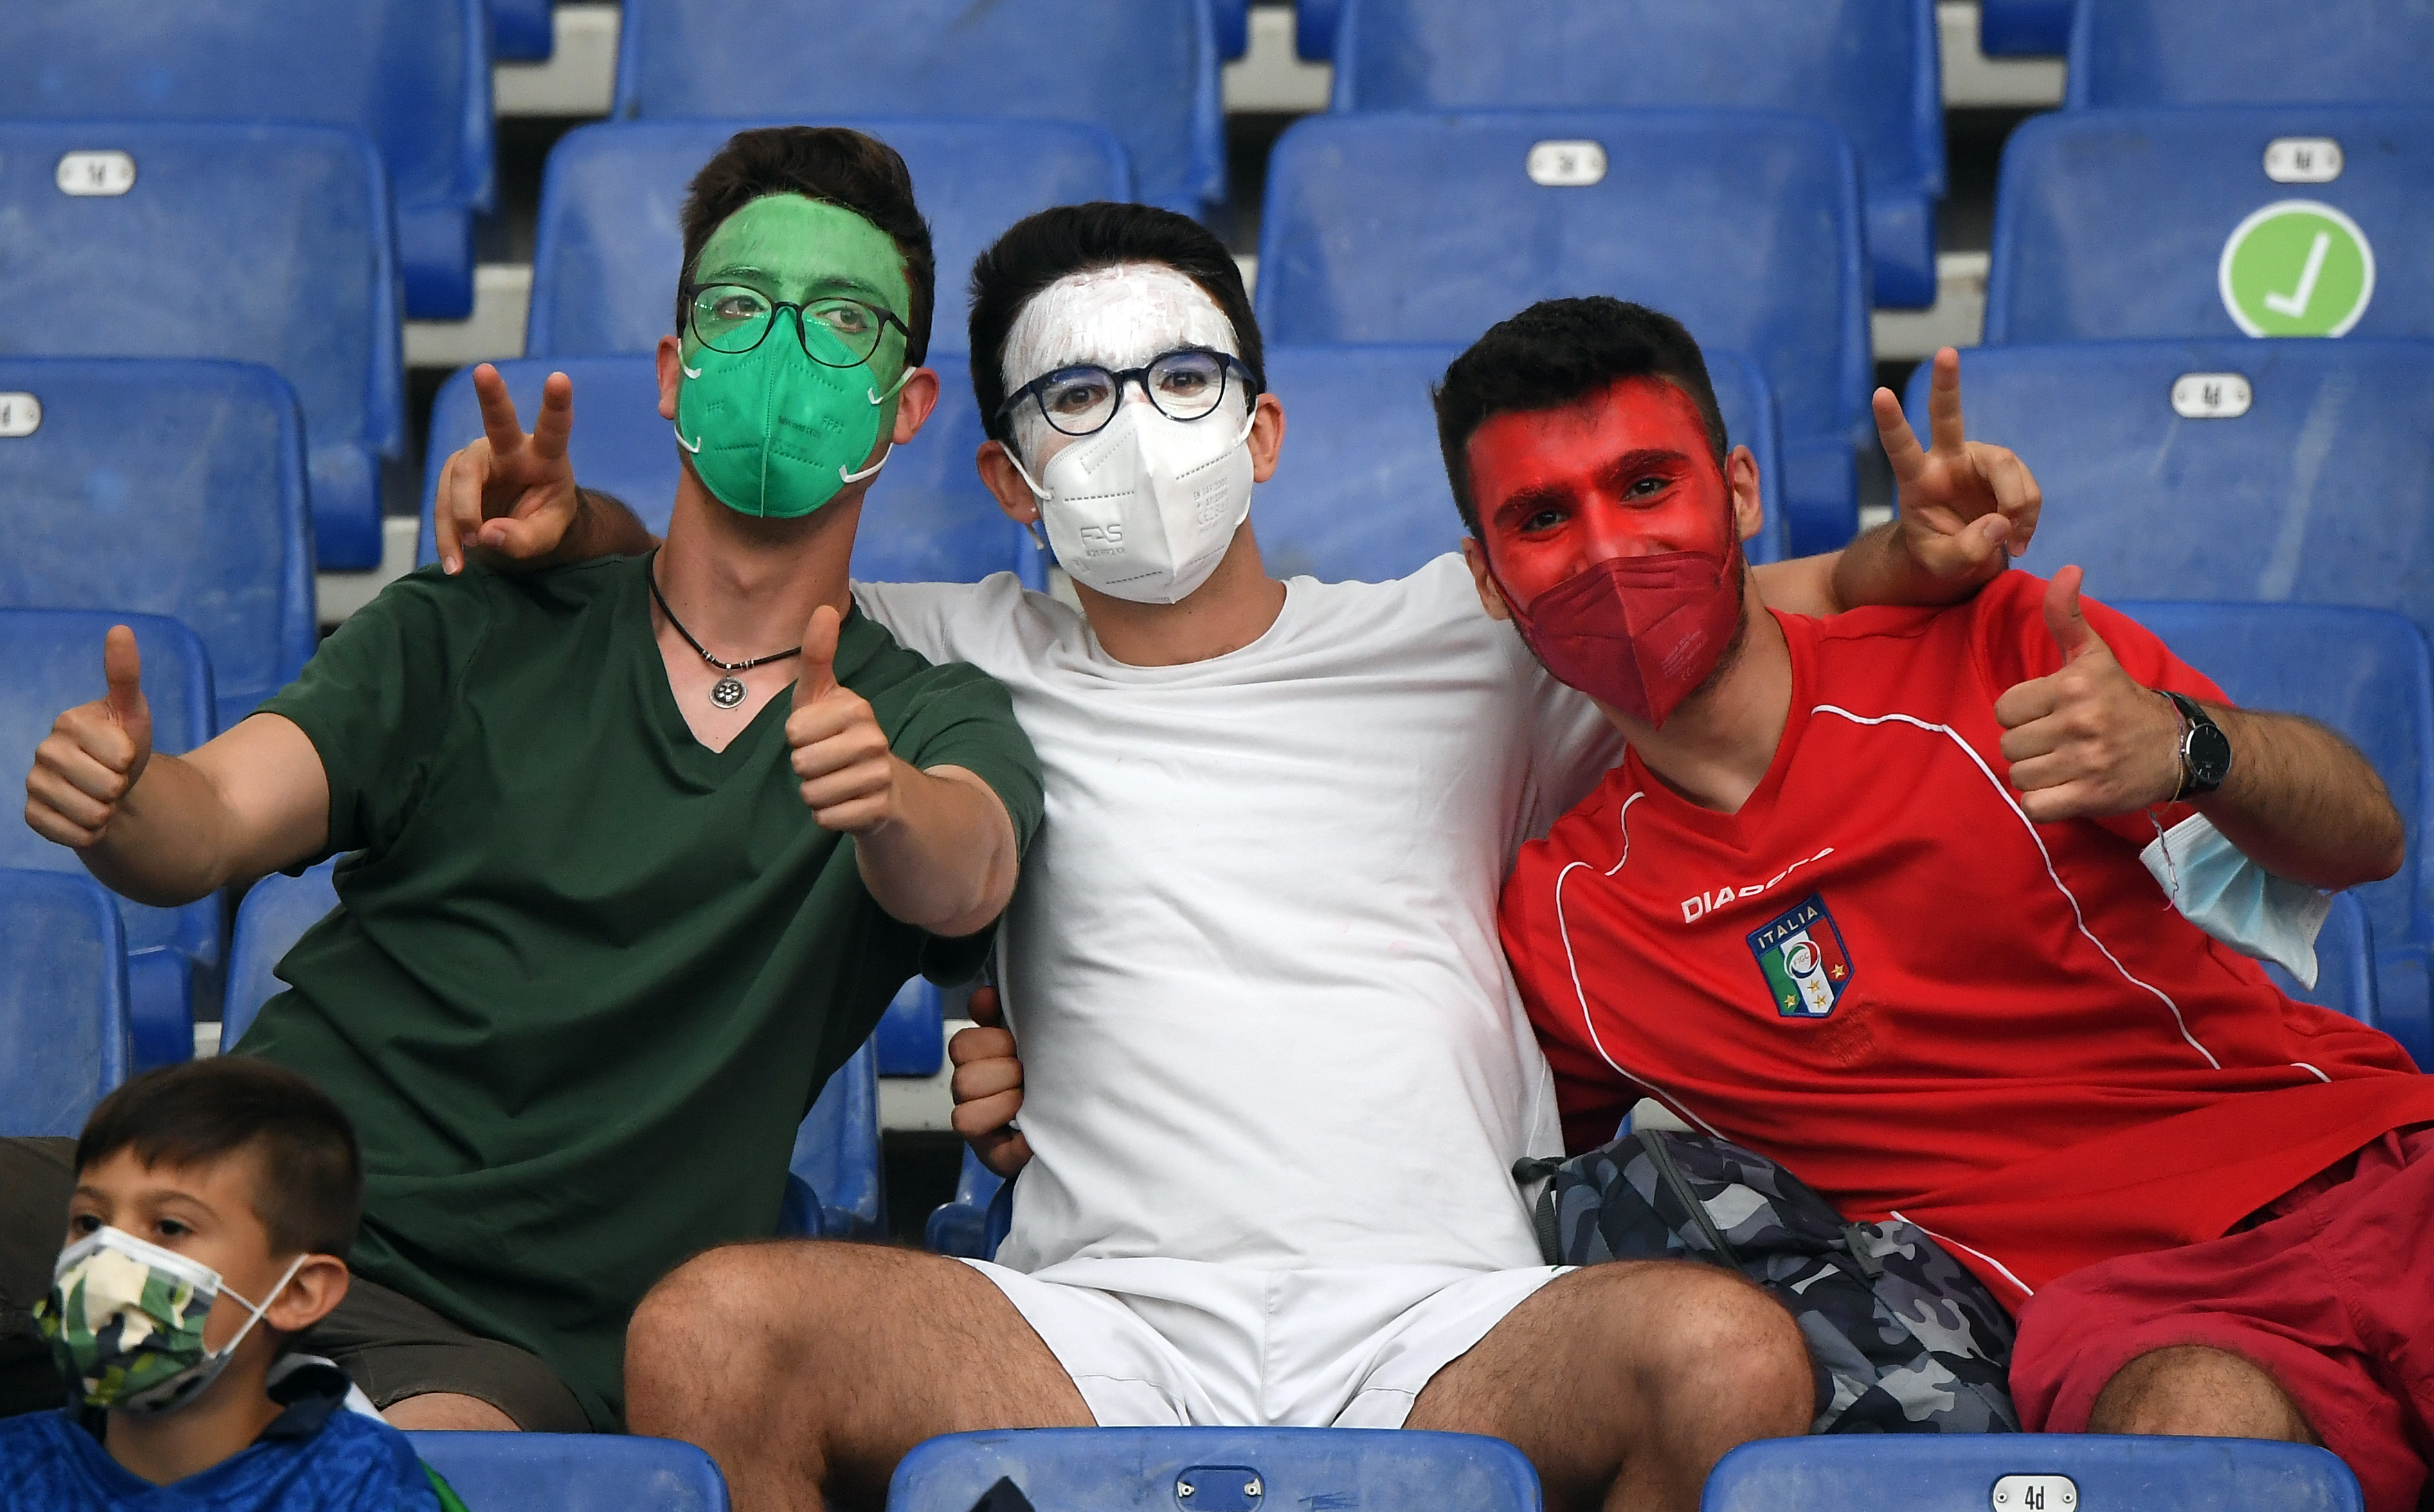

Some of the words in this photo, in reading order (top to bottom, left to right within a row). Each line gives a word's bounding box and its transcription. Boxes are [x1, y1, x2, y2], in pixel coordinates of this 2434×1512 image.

[1080, 524, 1122, 544] FAS
[1758, 906, 1818, 949] ITALIA
[1793, 951, 1810, 967] FIGC
[2025, 1486, 2044, 1510] 4d
